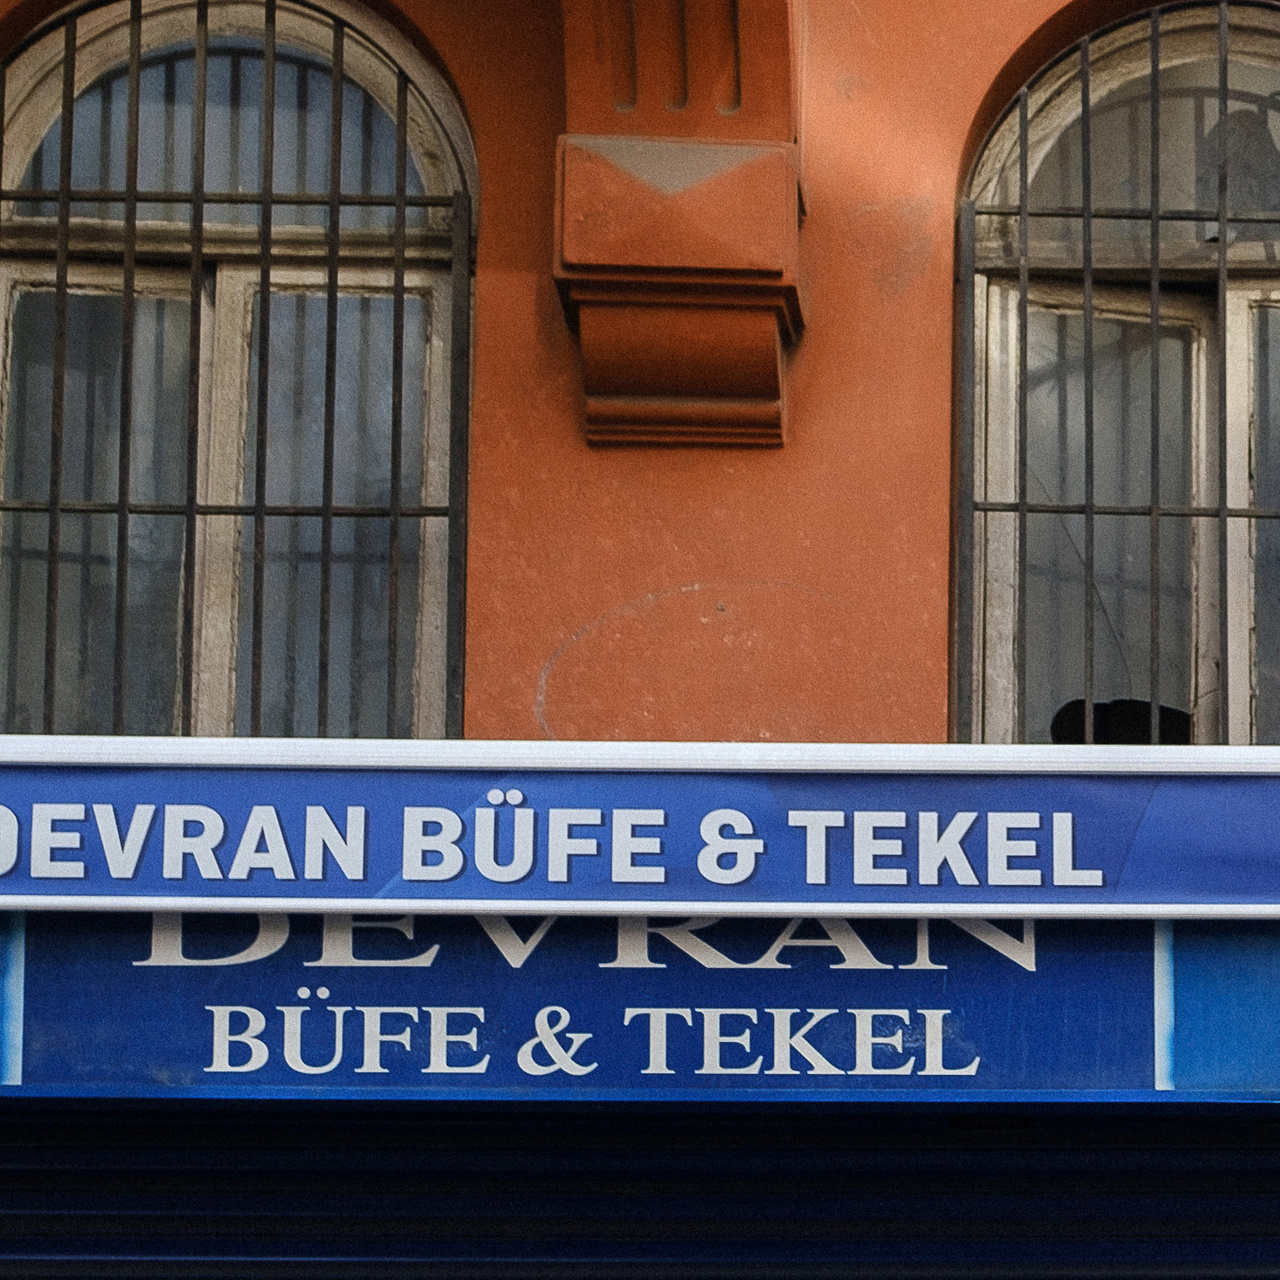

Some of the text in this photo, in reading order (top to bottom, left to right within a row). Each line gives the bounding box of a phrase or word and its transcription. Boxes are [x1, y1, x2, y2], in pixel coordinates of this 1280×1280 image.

[402, 788, 666, 883] BÜFE
[697, 808, 764, 885] &
[788, 810, 1104, 886] TEKEL
[203, 987, 981, 1076] BÜFE & TEKEL
